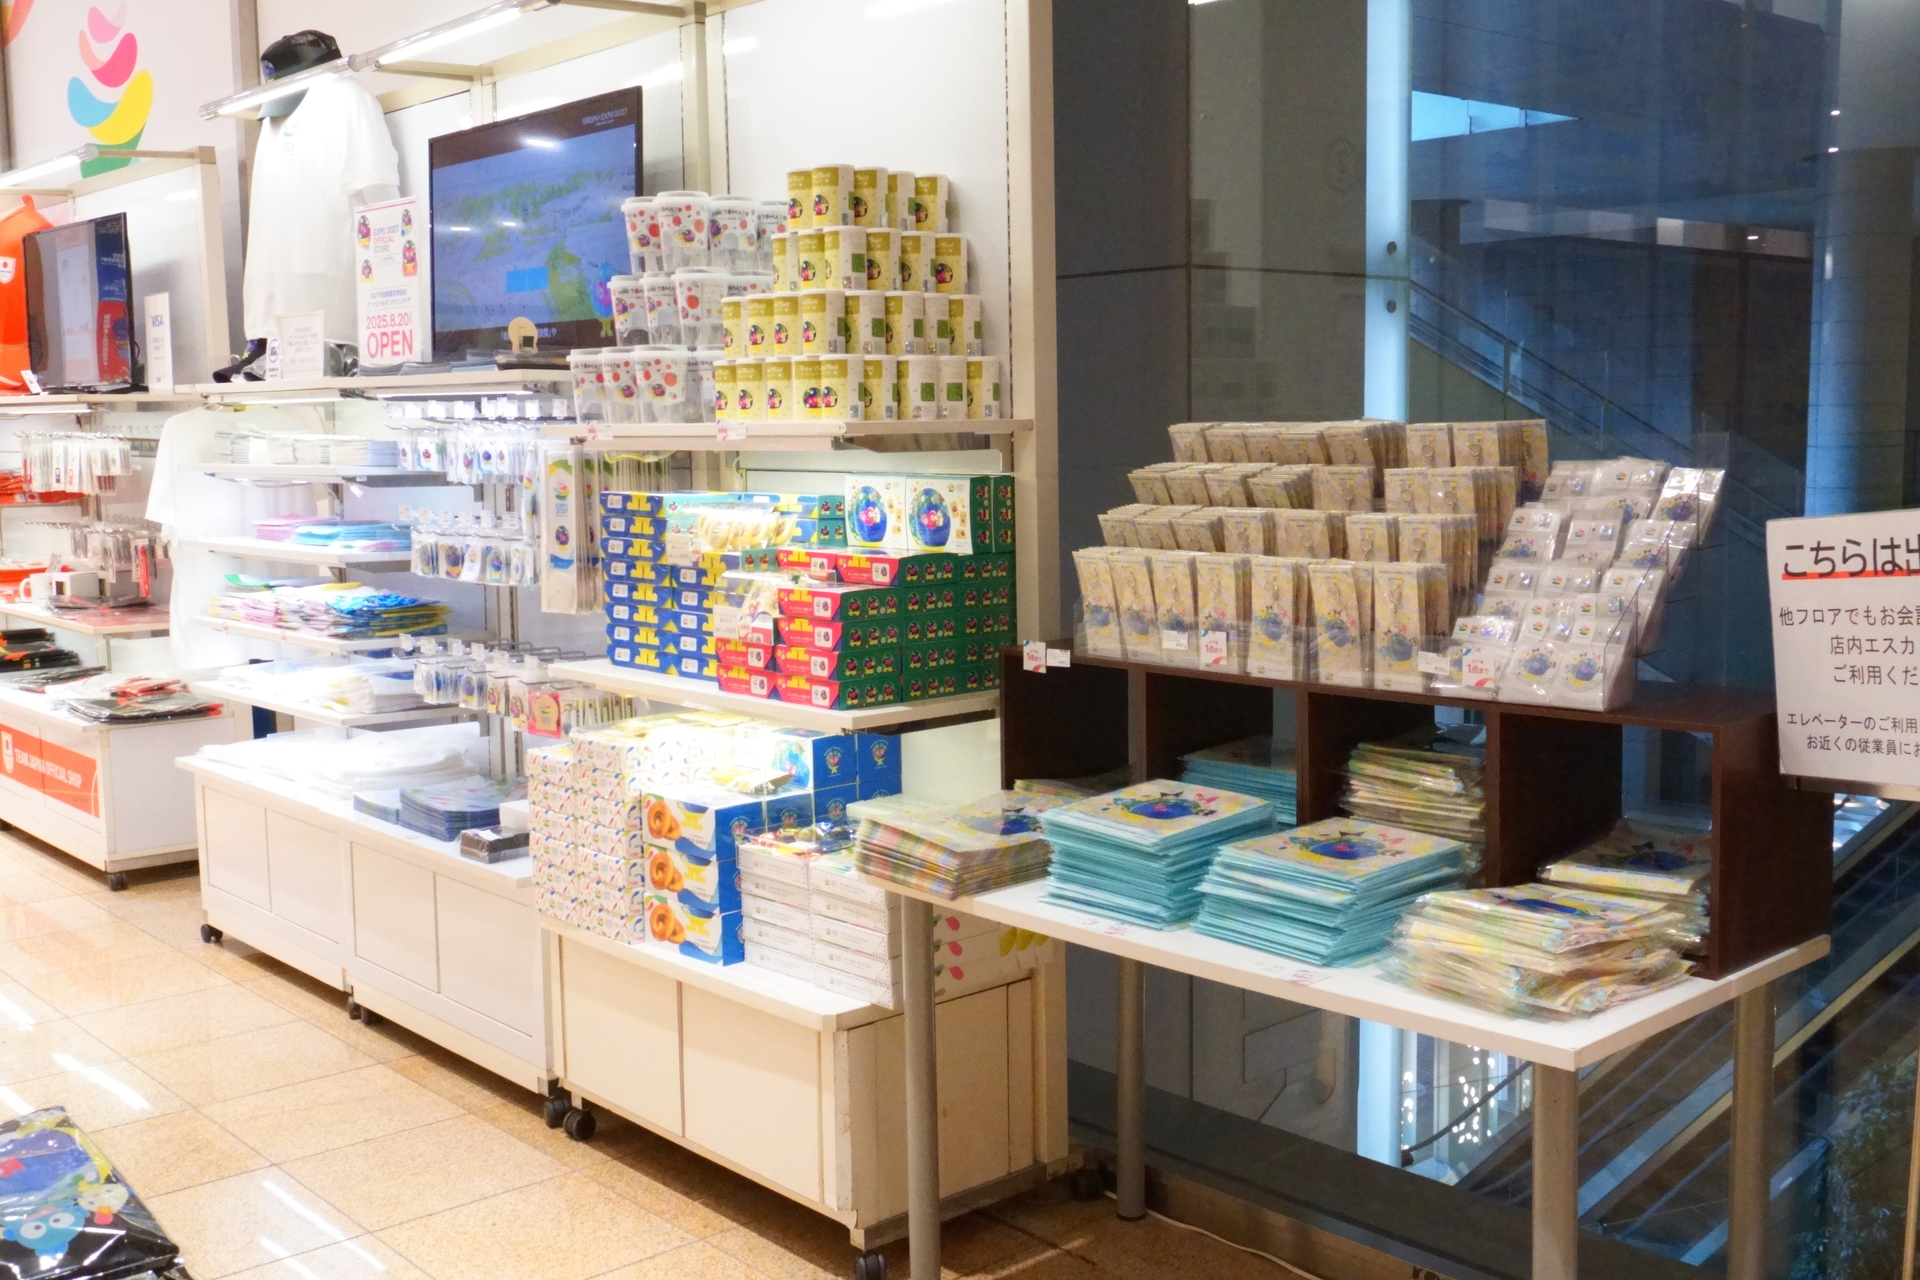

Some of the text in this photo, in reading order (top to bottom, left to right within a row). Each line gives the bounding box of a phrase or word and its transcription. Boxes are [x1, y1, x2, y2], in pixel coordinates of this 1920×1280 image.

[387, 225, 399, 234] 2027
[374, 236, 394, 245] OFFICIAL
[374, 245, 390, 254] STORE
[150, 314, 164, 328] VISA
[366, 312, 409, 330] 2025.8.20
[367, 329, 412, 359] OPEN
[1780, 604, 1920, 626] 他フロアでもお会
[1830, 635, 1916, 656] 店内エスカ
[1467, 664, 1490, 675] 1点まで
[1833, 664, 1919, 686] ご利用くだ
[1787, 713, 1918, 734] エレベーターのご利用
[15, 749, 82, 788] TEAM JAPAN OFFICIAL SHOP
